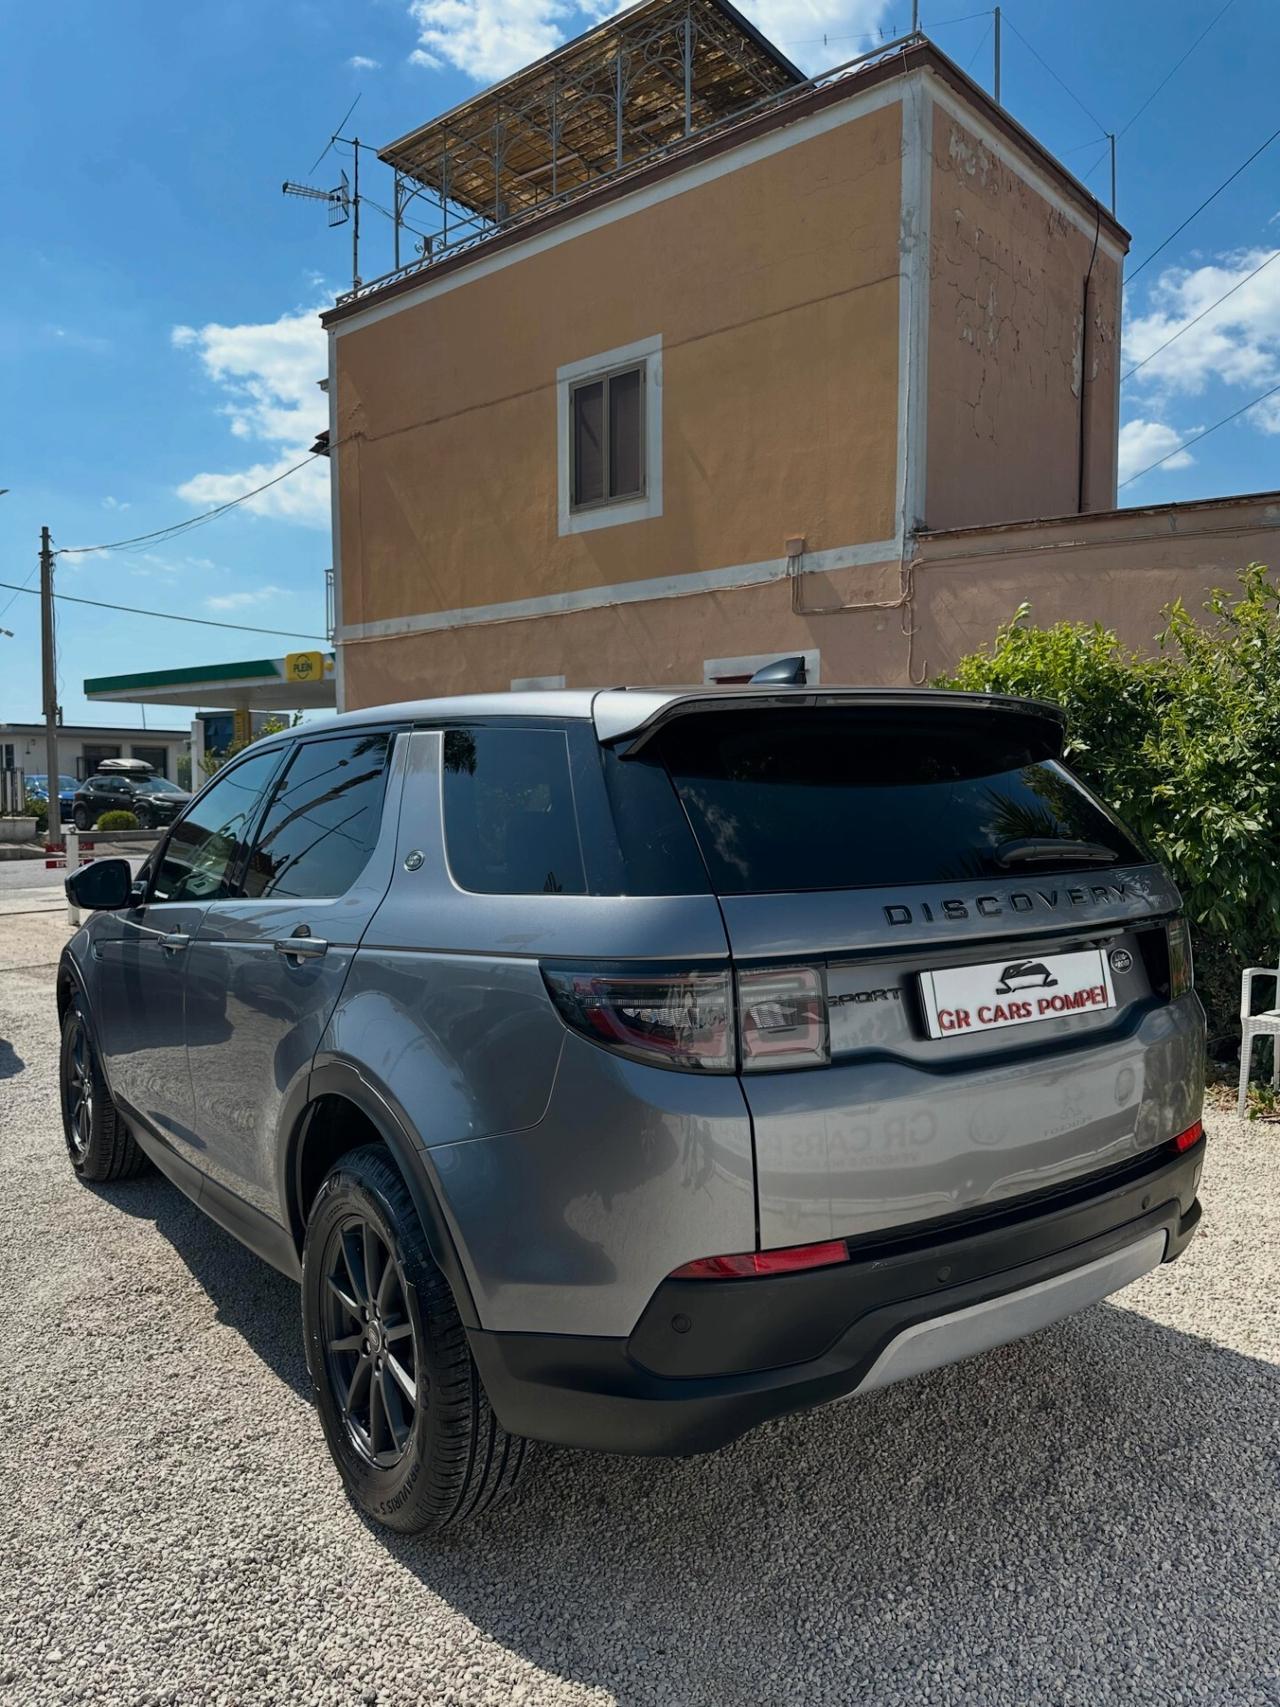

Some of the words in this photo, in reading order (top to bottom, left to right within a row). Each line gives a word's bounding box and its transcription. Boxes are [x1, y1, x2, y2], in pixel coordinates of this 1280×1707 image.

[883, 884, 1127, 926] DISCOVERY
[827, 987, 904, 1007] SPORT
[938, 1008, 971, 1031] GR
[978, 1001, 1033, 1026] CARS
[1038, 985, 1108, 1016] POMPEI
